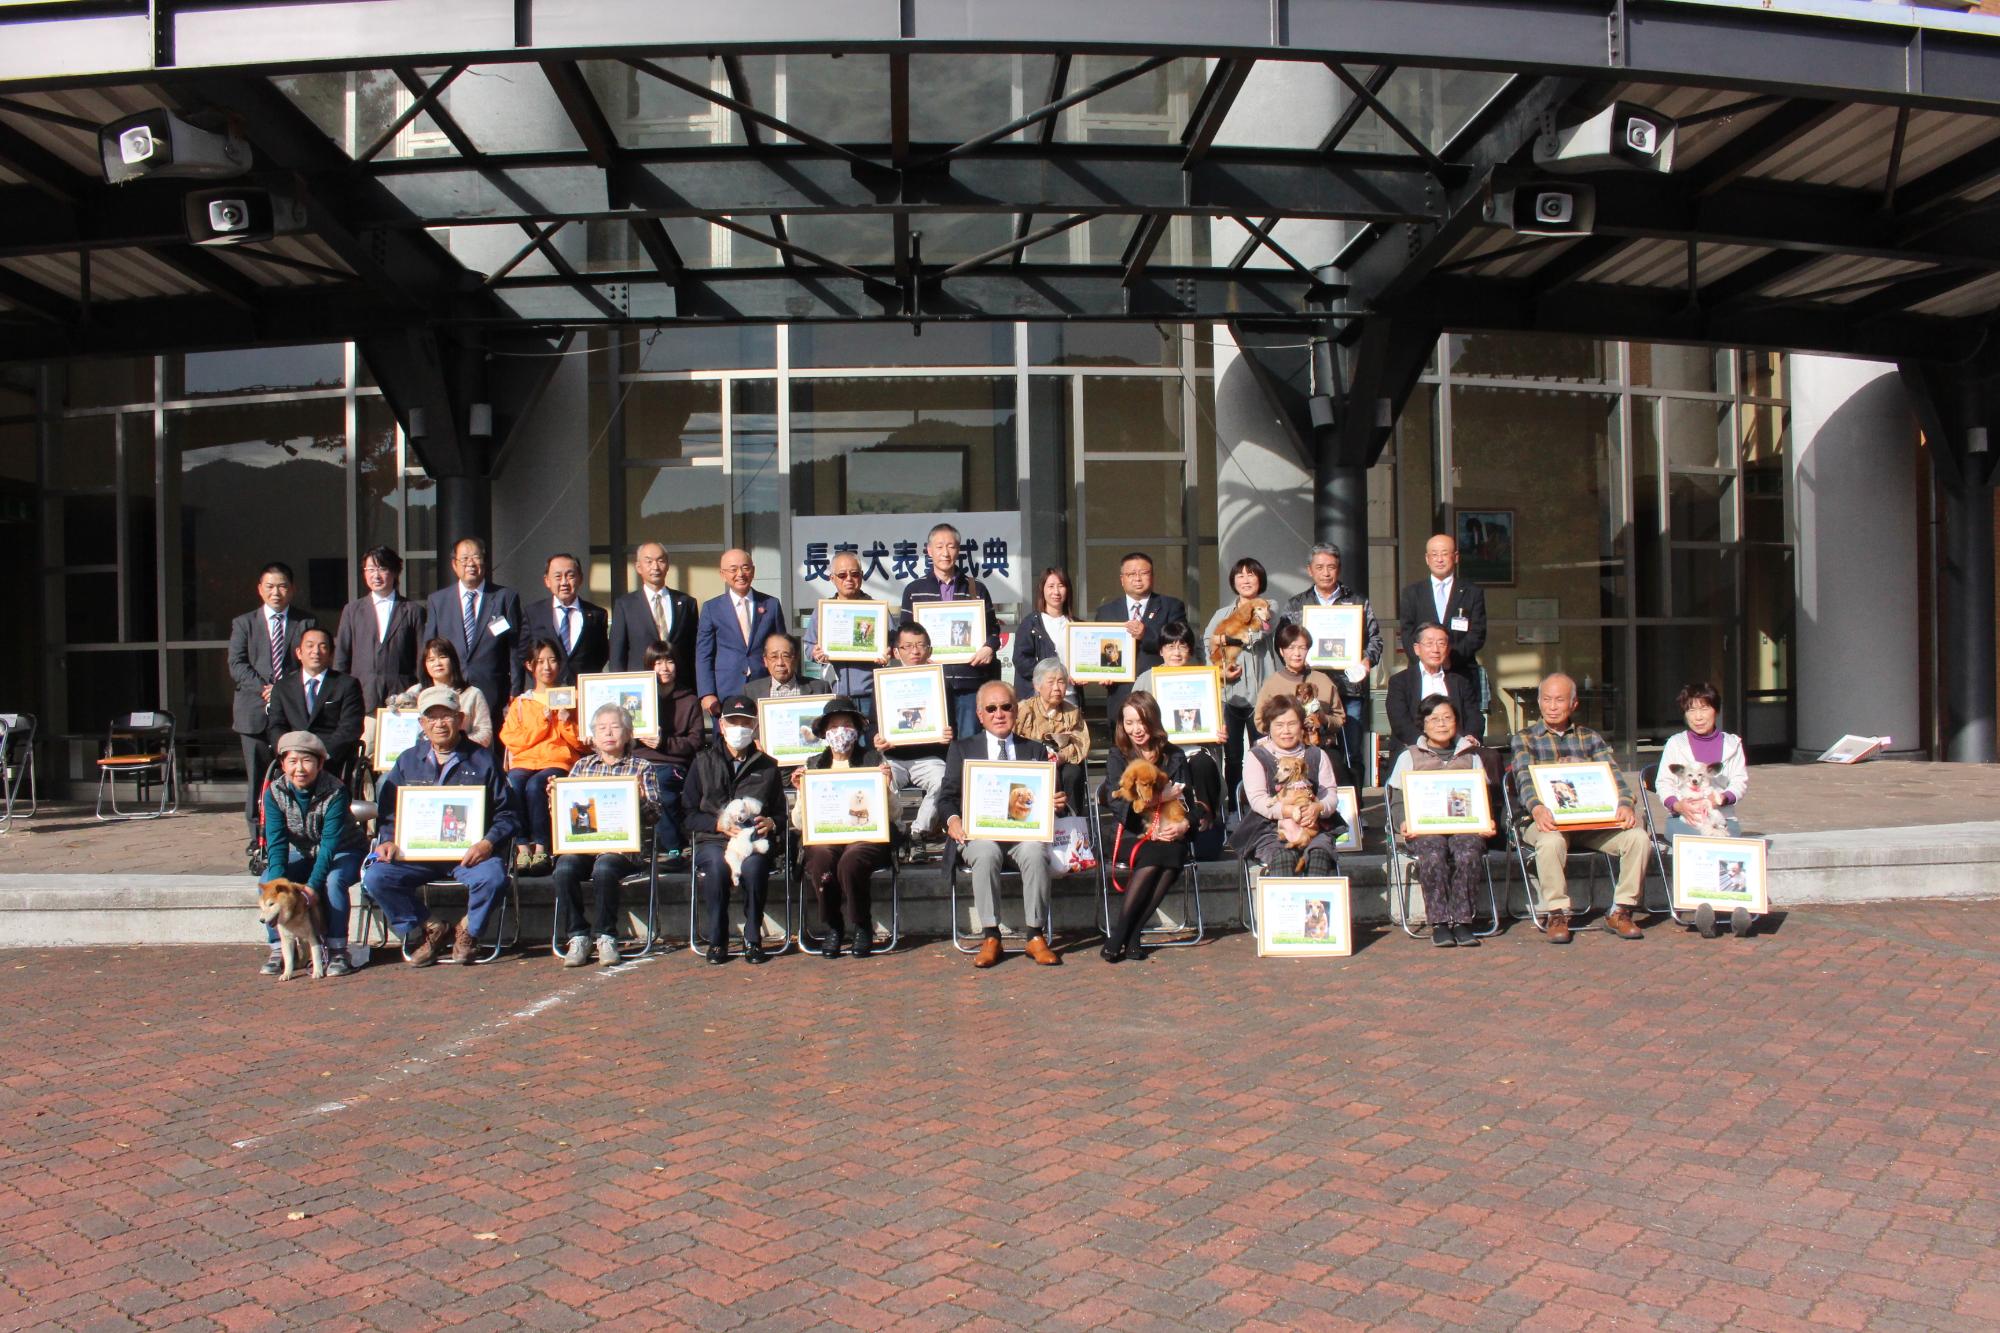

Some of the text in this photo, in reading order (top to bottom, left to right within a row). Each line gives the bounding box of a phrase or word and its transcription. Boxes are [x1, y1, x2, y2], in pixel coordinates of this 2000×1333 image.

[804, 537, 1009, 581] 長犬表式典
